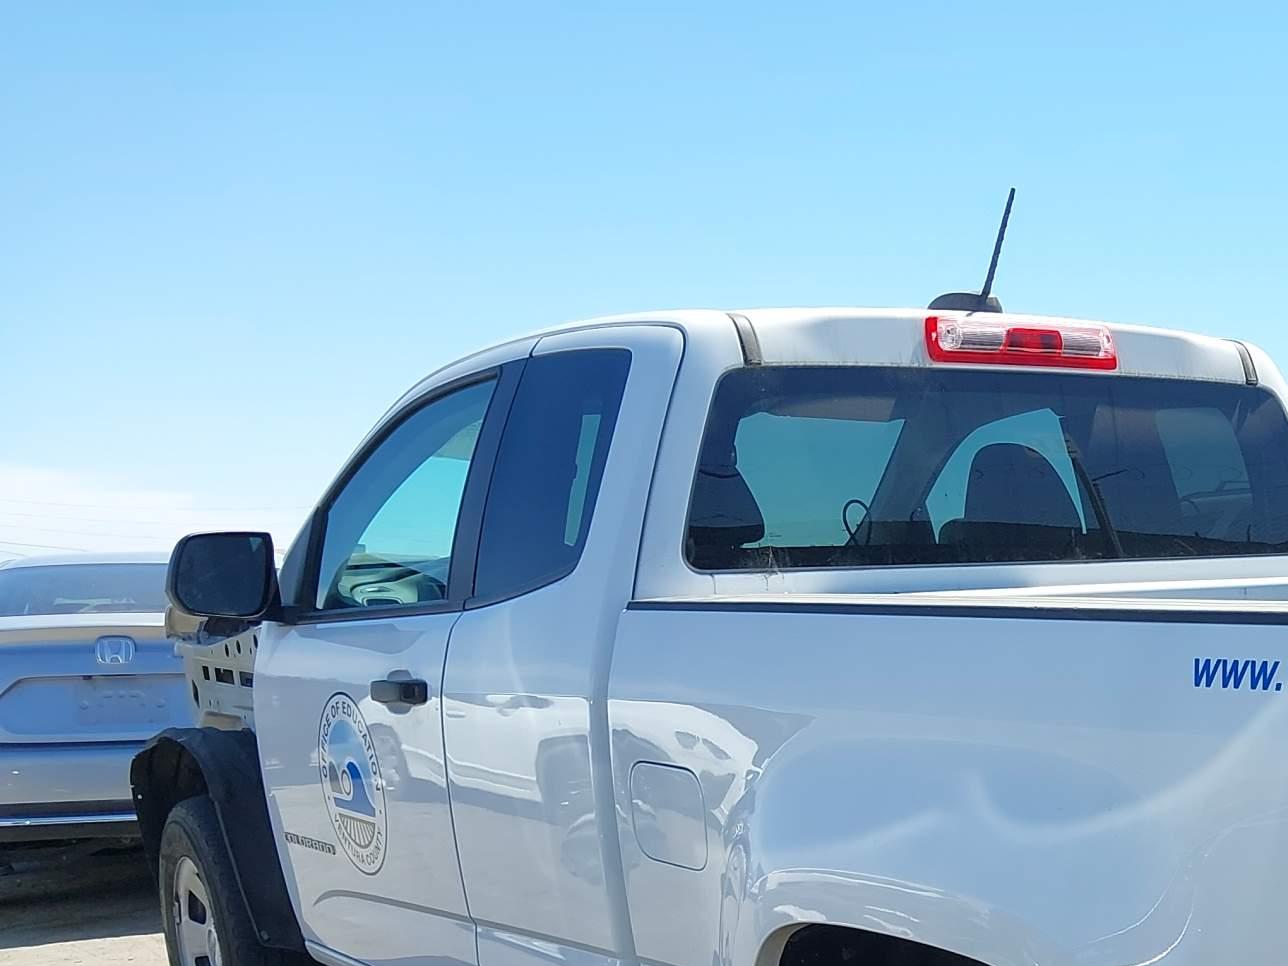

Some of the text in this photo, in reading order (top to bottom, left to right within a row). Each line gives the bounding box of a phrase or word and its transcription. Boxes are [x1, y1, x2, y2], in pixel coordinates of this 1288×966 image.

[321, 701, 381, 792] OFFICE OF EDUCATION
[335, 812, 383, 866] VENTURA COUNTY
